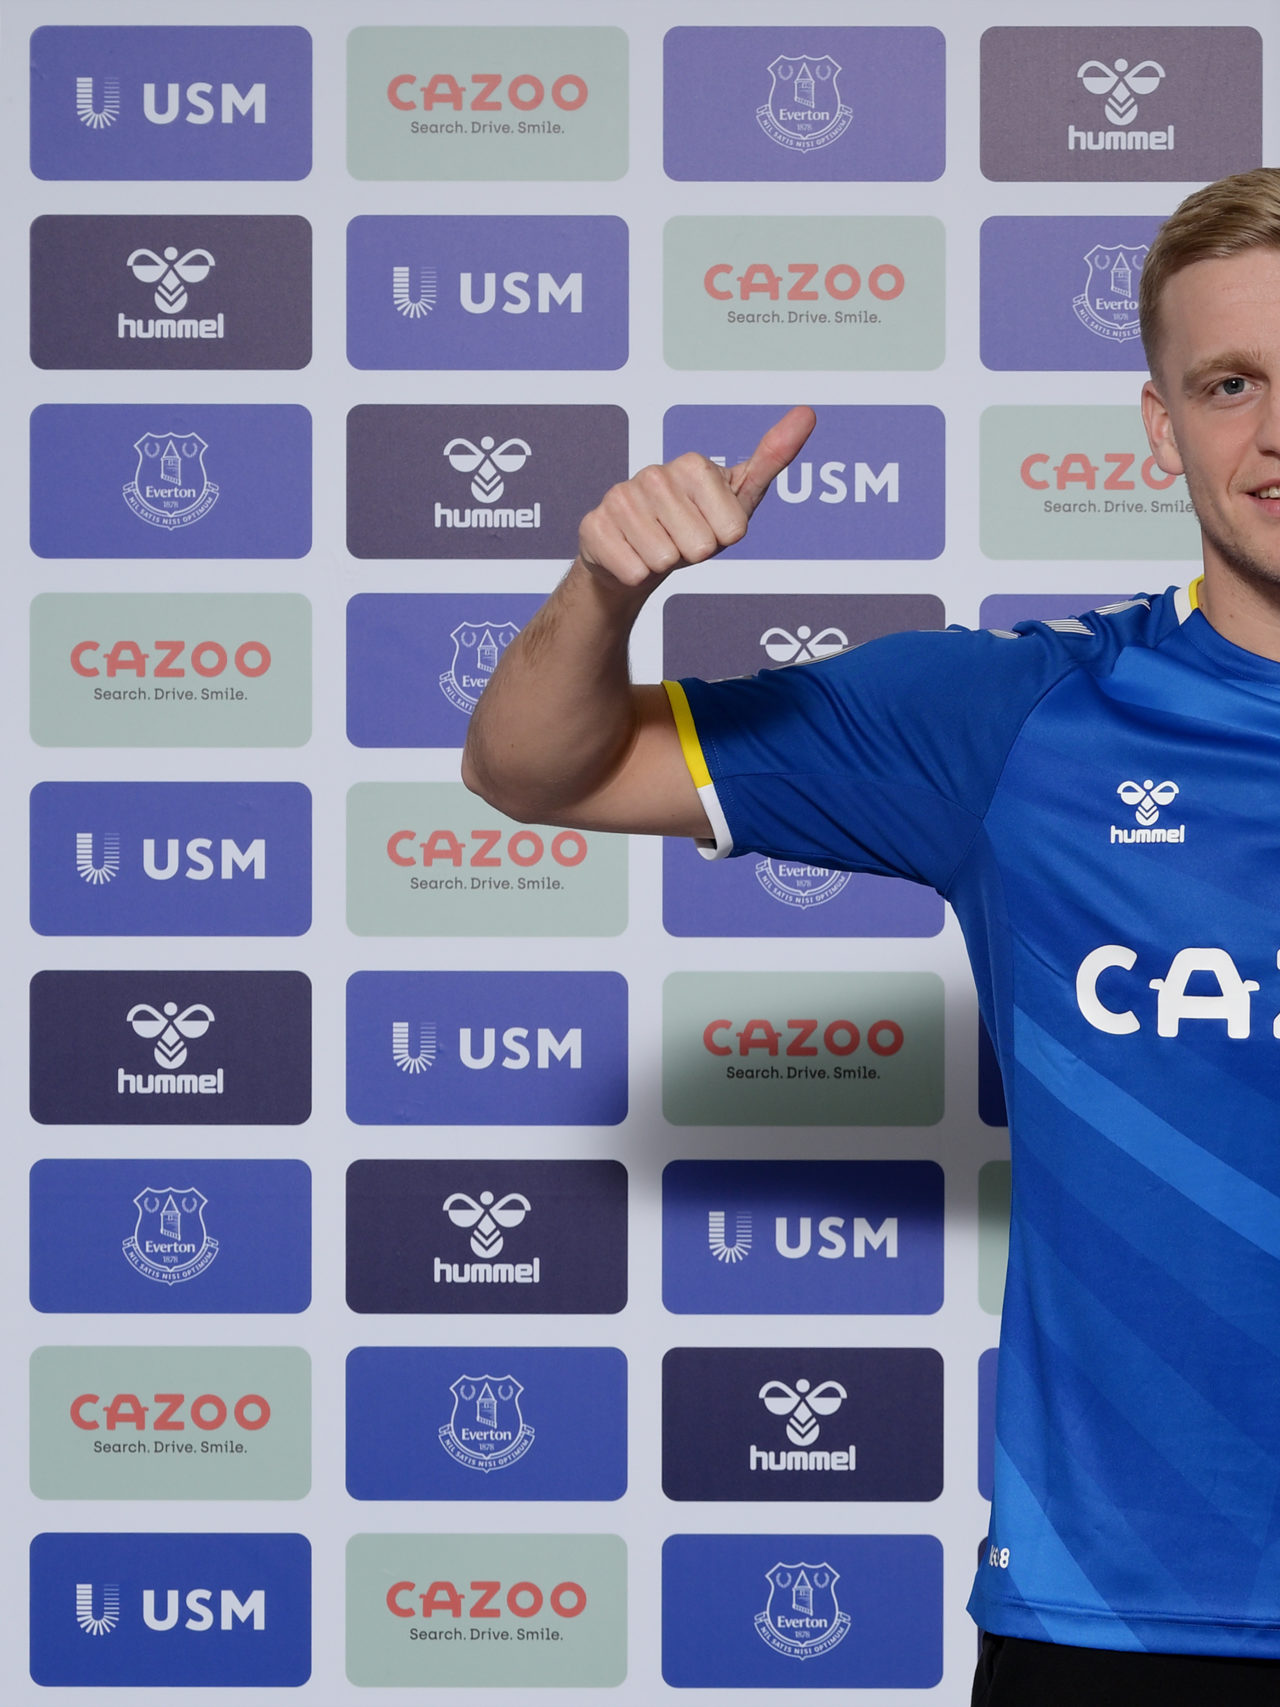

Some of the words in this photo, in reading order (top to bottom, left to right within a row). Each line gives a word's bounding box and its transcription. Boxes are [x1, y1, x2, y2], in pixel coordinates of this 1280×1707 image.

[142, 81, 266, 125] USM
[387, 73, 588, 111] CAZOO
[410, 120, 468, 134] Search.
[470, 120, 514, 134] Drive.
[517, 120, 565, 134] Smile.
[779, 108, 830, 121] Everton
[1068, 124, 1175, 150] hummel
[459, 271, 583, 315] USM
[704, 263, 905, 301] CAZOO
[727, 310, 785, 324] Search.
[787, 310, 831, 324] Drive.
[834, 310, 882, 324] Smile.
[1095, 298, 1139, 310] Everto
[117, 313, 224, 339] hummel
[775, 461, 899, 505] USM
[1020, 453, 1177, 491] CAZO
[145, 485, 196, 498] Everton
[434, 502, 541, 528] hummel
[1043, 500, 1101, 514] Search.
[1103, 500, 1147, 514] Drive.
[1150, 500, 1194, 513] Smile
[70, 640, 271, 678] CAZOO
[93, 687, 151, 701] Search.
[153, 687, 197, 701] Drive.
[200, 687, 248, 701] Smile.
[462, 675, 489, 688] Ever
[1110, 824, 1186, 844] hummel
[142, 837, 266, 881] USM
[387, 830, 588, 868] CAZOO
[778, 864, 829, 877] Everton
[410, 877, 468, 891] Search.
[470, 877, 514, 891] Drive.
[517, 877, 565, 891] Smile.
[458, 1026, 582, 1070] USM
[703, 1019, 904, 1057] CAZOO
[117, 1068, 224, 1094] hummel
[726, 1066, 784, 1080] Search.
[786, 1066, 830, 1080] Drive.
[833, 1066, 881, 1080] Smile.
[145, 1240, 196, 1253] Everton
[774, 1216, 898, 1260] USM
[433, 1257, 540, 1283] hummel
[70, 1393, 271, 1431] CAZOO
[93, 1440, 151, 1454] Search.
[153, 1440, 197, 1454] Drive.
[200, 1440, 248, 1454] Smile.
[461, 1428, 512, 1441] Everton
[749, 1445, 856, 1471] hummel
[142, 1588, 266, 1632] USM
[386, 1580, 587, 1618] CAZOO
[409, 1627, 467, 1641] Search.
[469, 1627, 513, 1641] Drive.
[516, 1627, 564, 1641] Smile.
[777, 1615, 828, 1628] Everton
